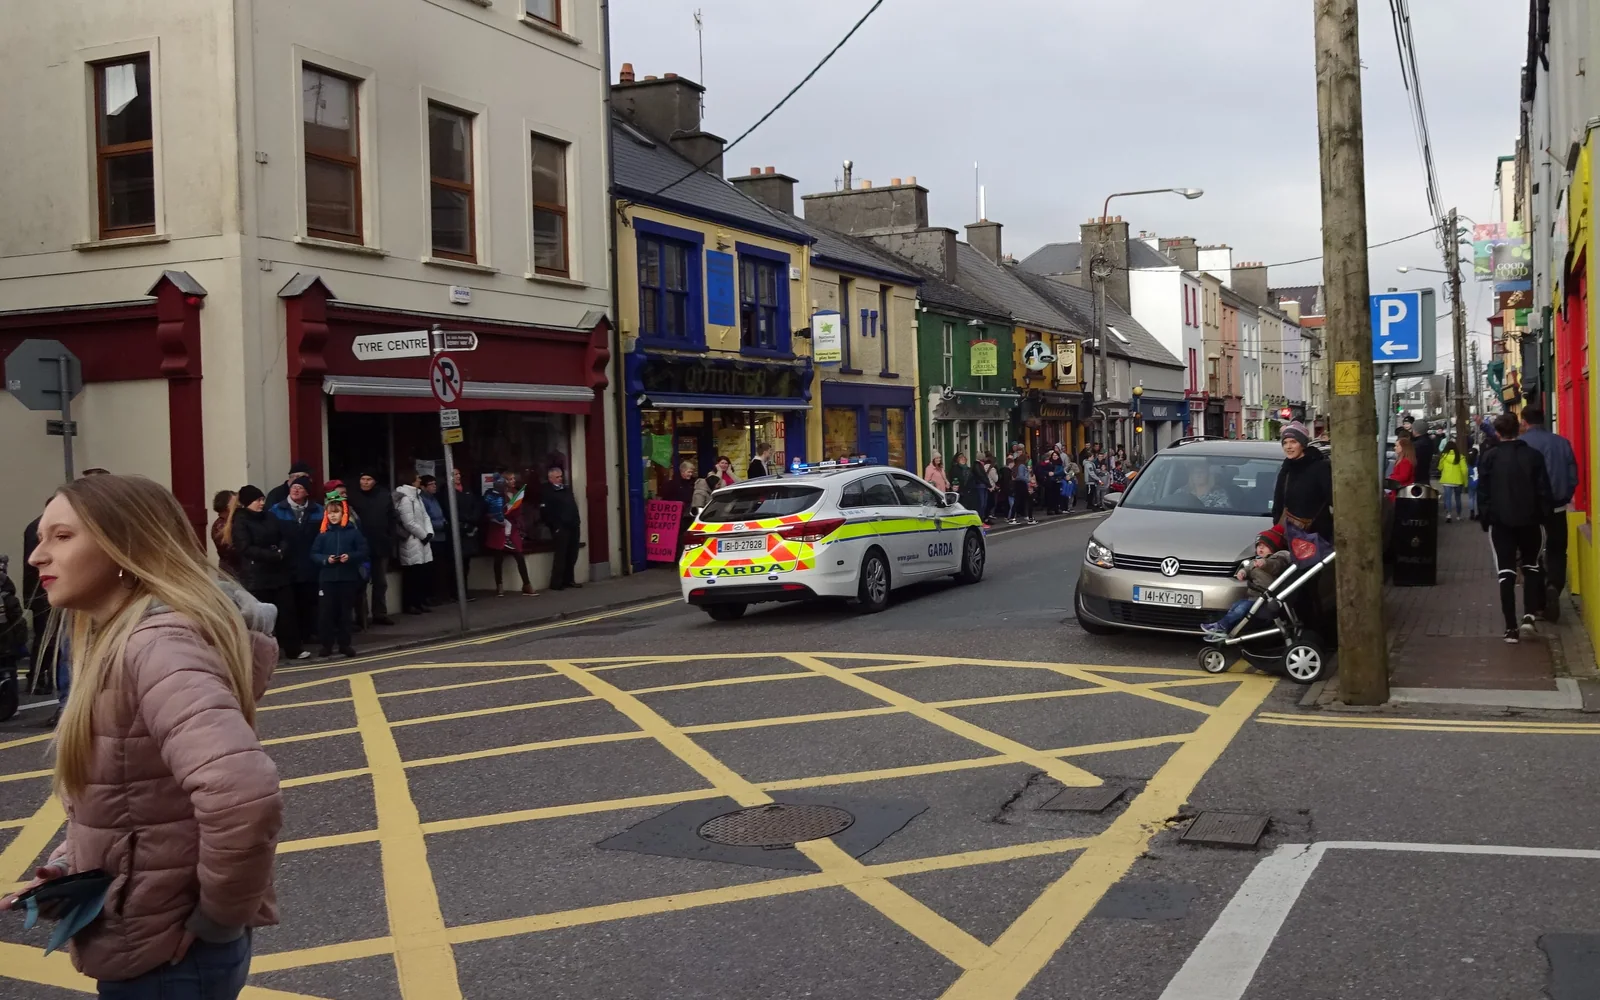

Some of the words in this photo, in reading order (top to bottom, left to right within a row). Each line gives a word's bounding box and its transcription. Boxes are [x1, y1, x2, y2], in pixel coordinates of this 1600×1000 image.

[1497, 262, 1524, 270] GOOD
[1495, 267, 1528, 277] FOOD
[1380, 299, 1407, 336] P
[357, 341, 384, 352] TYRE
[387, 338, 428, 350] CENTRE
[650, 503, 678, 512] EURO
[648, 512, 677, 521] LOTTO
[651, 534, 659, 543] 2
[928, 542, 953, 557] GARDA
[699, 564, 785, 576] GARDA
[1144, 590, 1194, 605] 141-KY-1290
